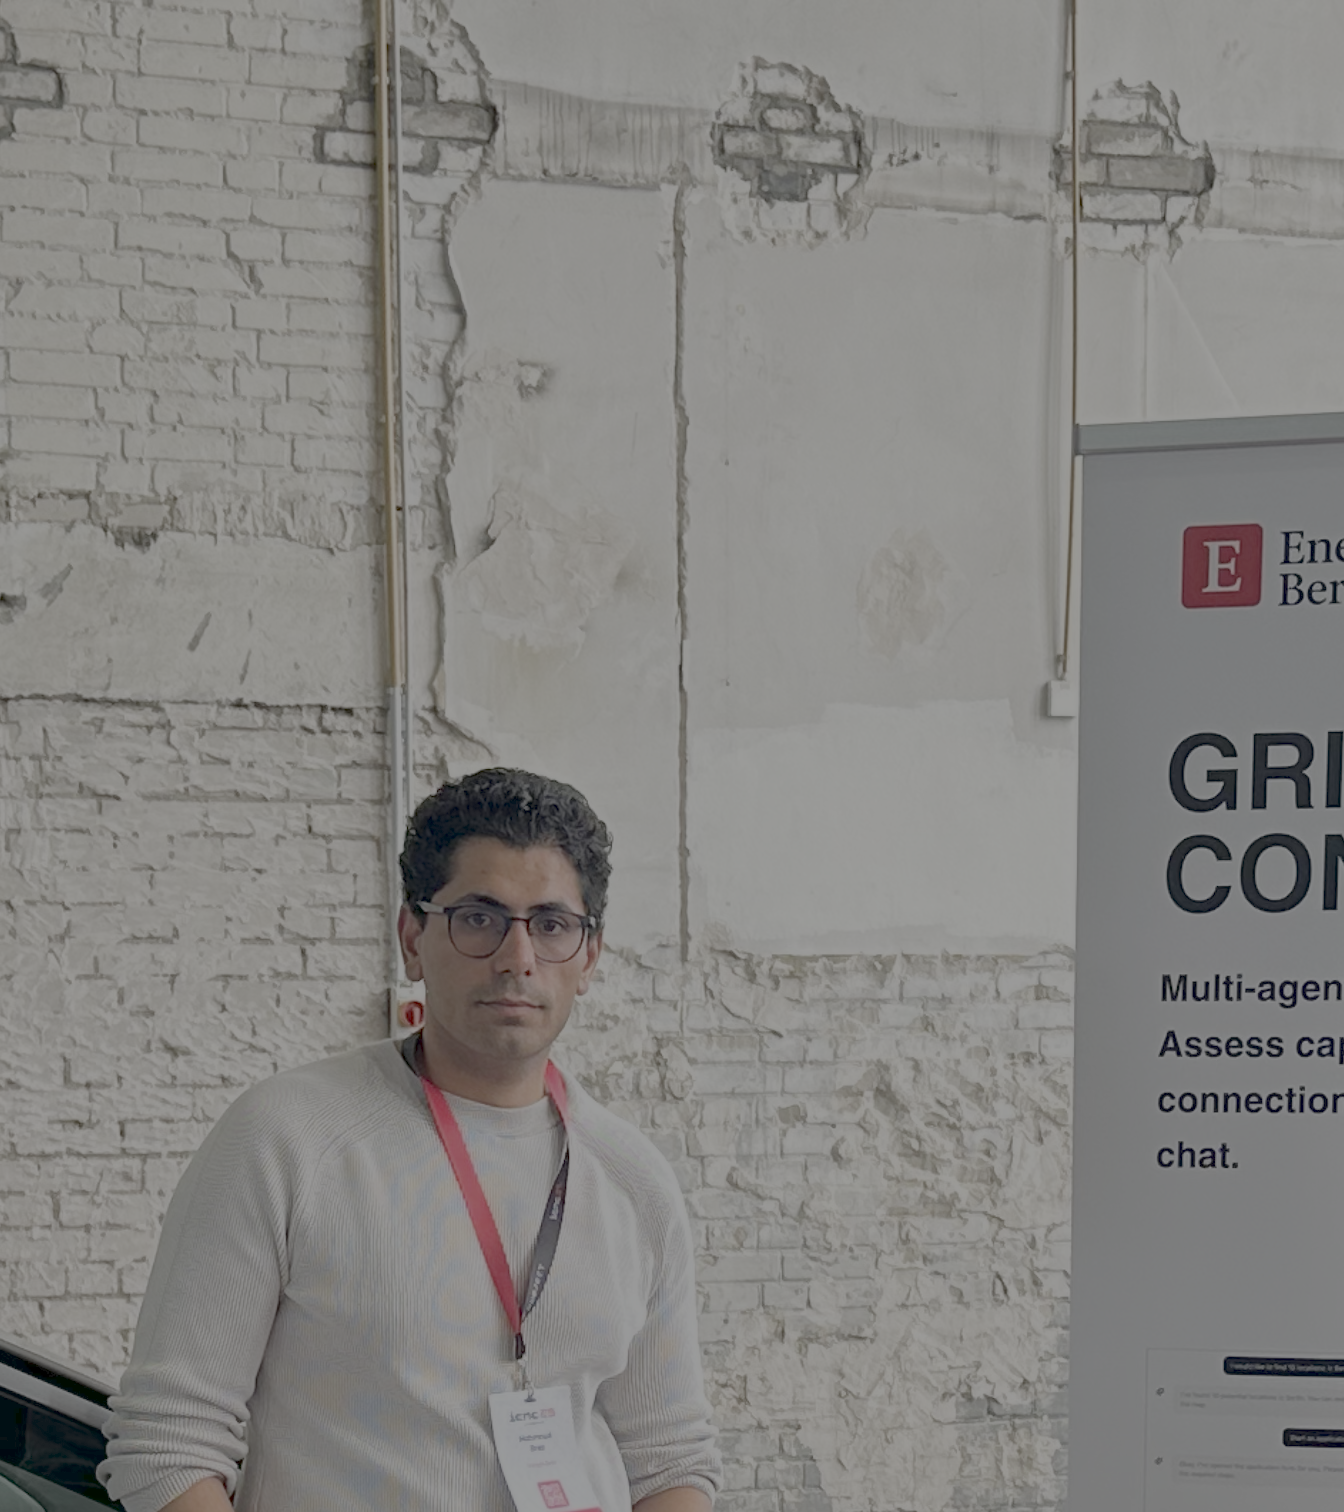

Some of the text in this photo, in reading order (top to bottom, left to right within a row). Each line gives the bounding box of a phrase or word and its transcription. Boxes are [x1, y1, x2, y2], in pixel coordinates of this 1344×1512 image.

[1202, 540, 1241, 592] E
[1159, 1031, 1283, 1057] Assess
[1157, 1141, 1238, 1168] chat.
